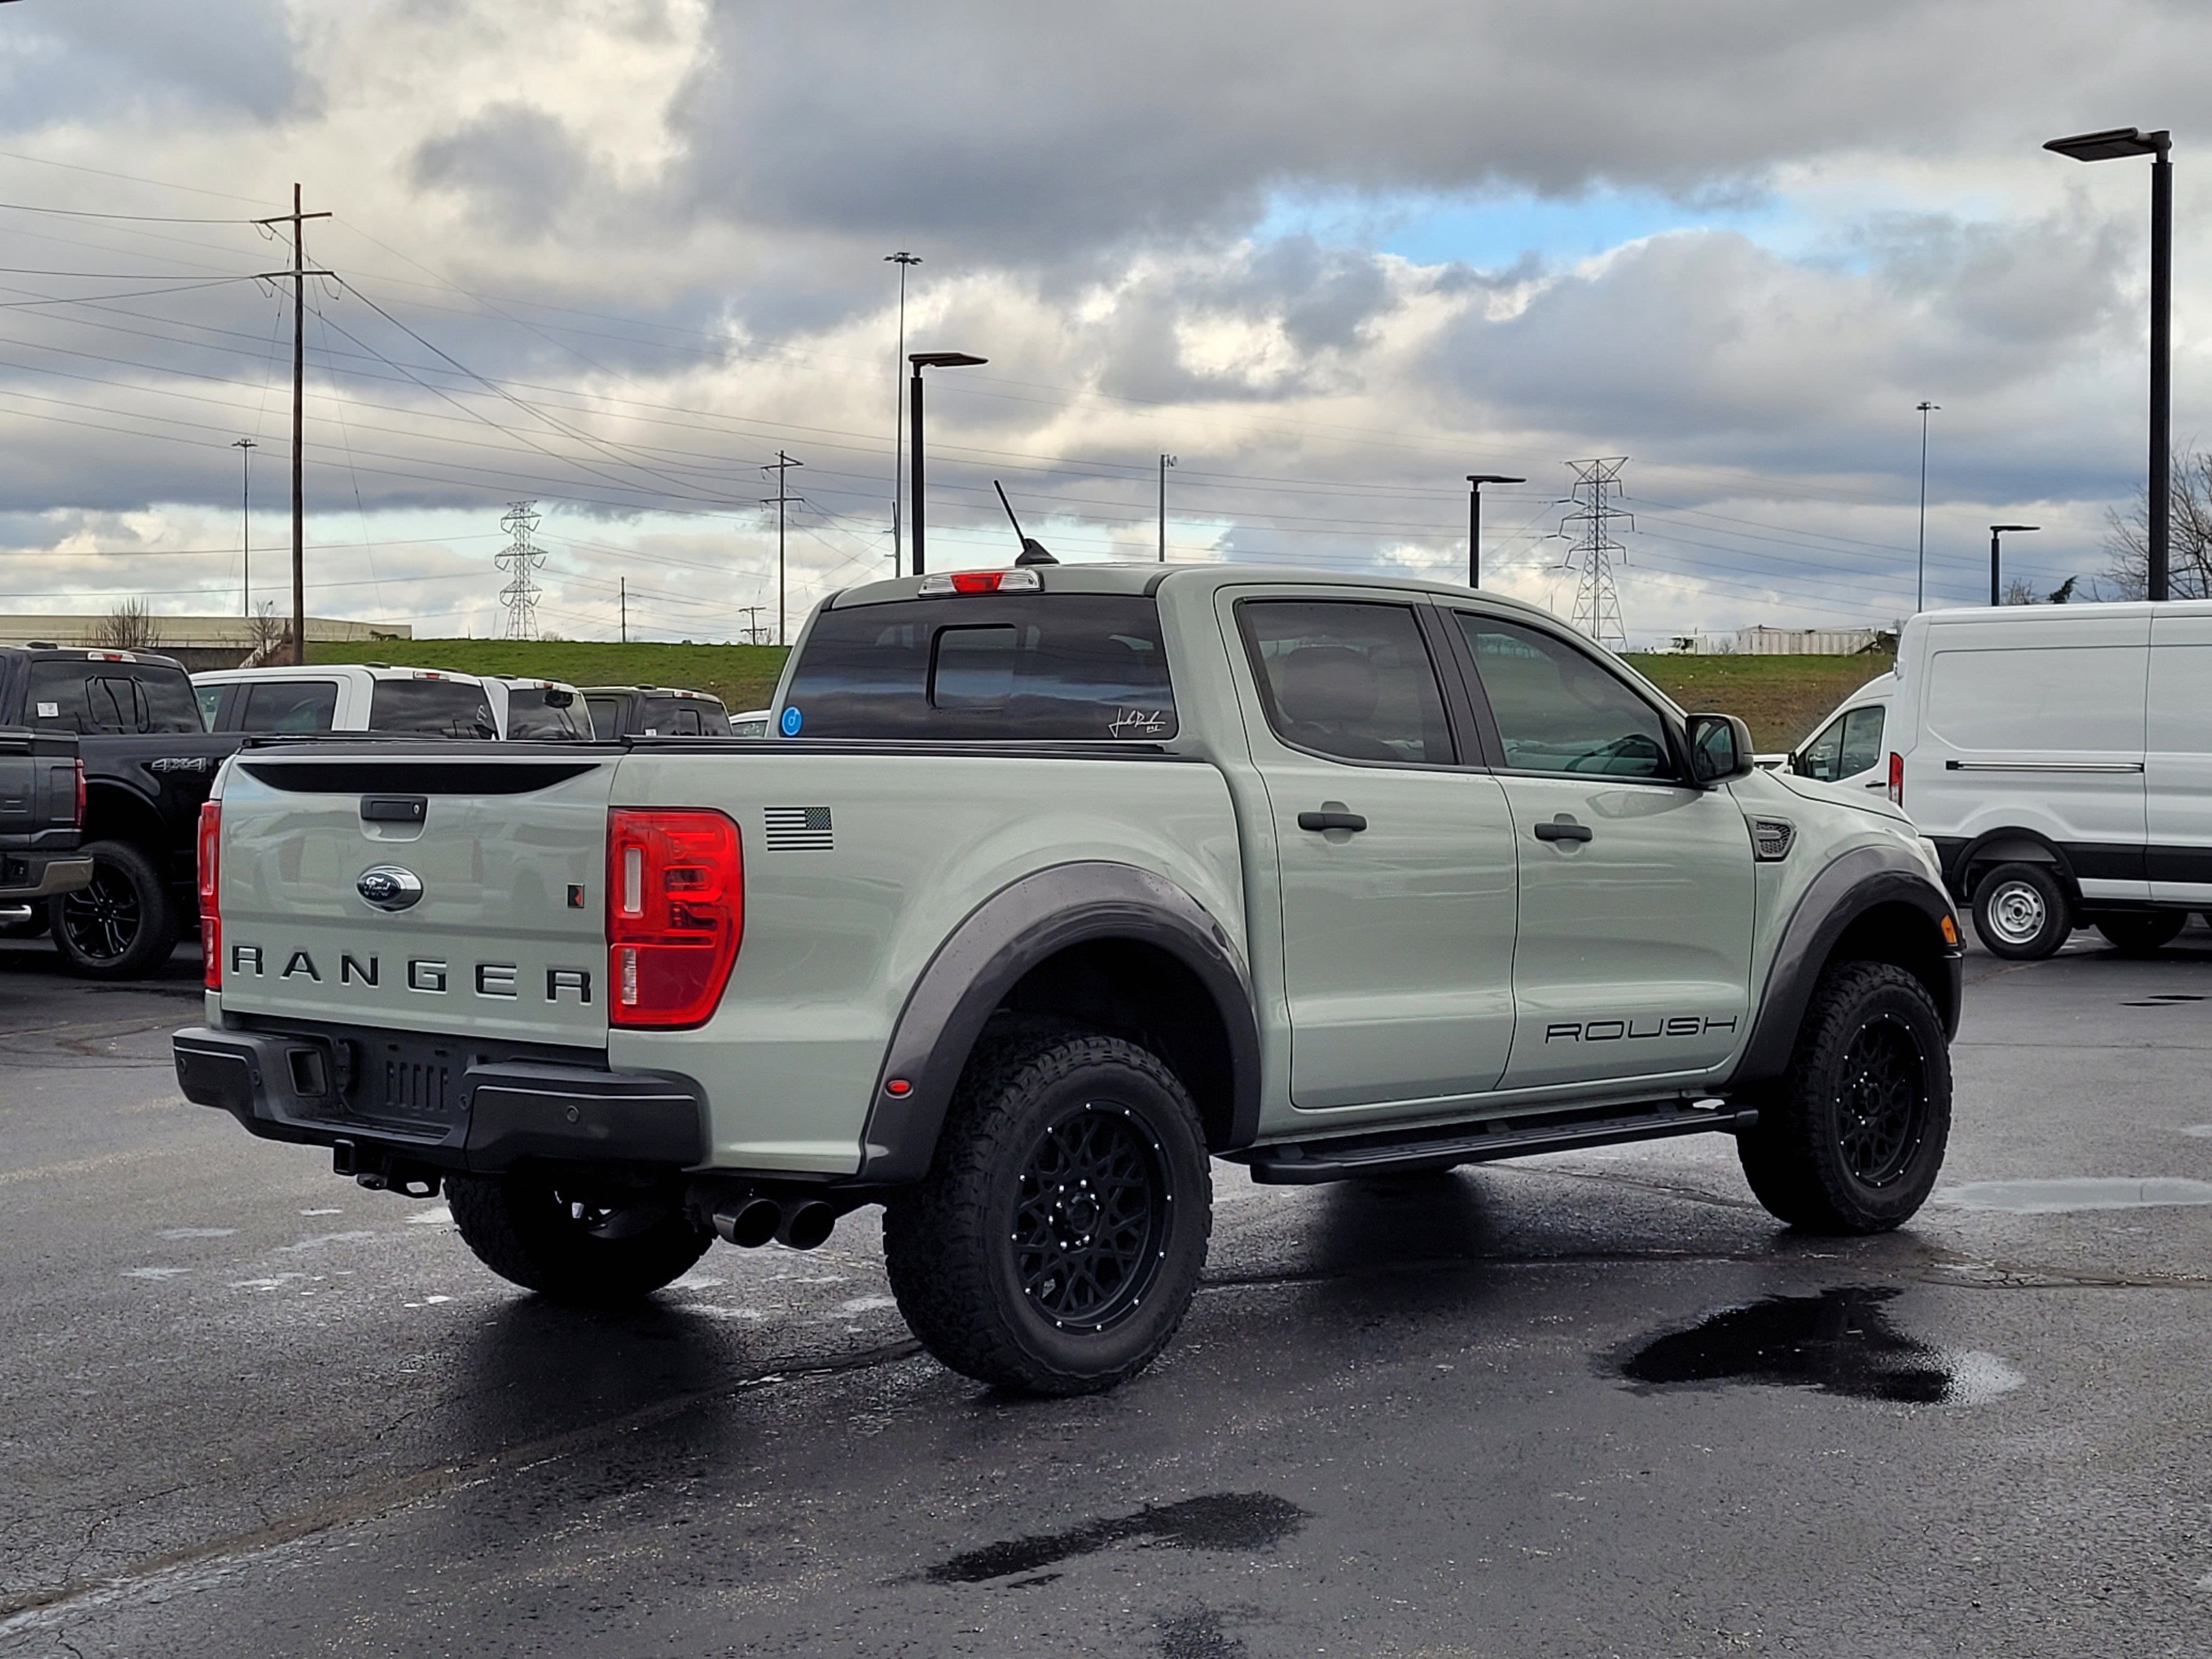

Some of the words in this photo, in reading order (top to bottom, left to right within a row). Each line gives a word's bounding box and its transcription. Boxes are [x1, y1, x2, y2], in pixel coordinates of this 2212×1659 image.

[364, 876, 391, 896] Ford
[232, 944, 592, 1006] RANGER
[1544, 1015, 1738, 1044] ROUSH
